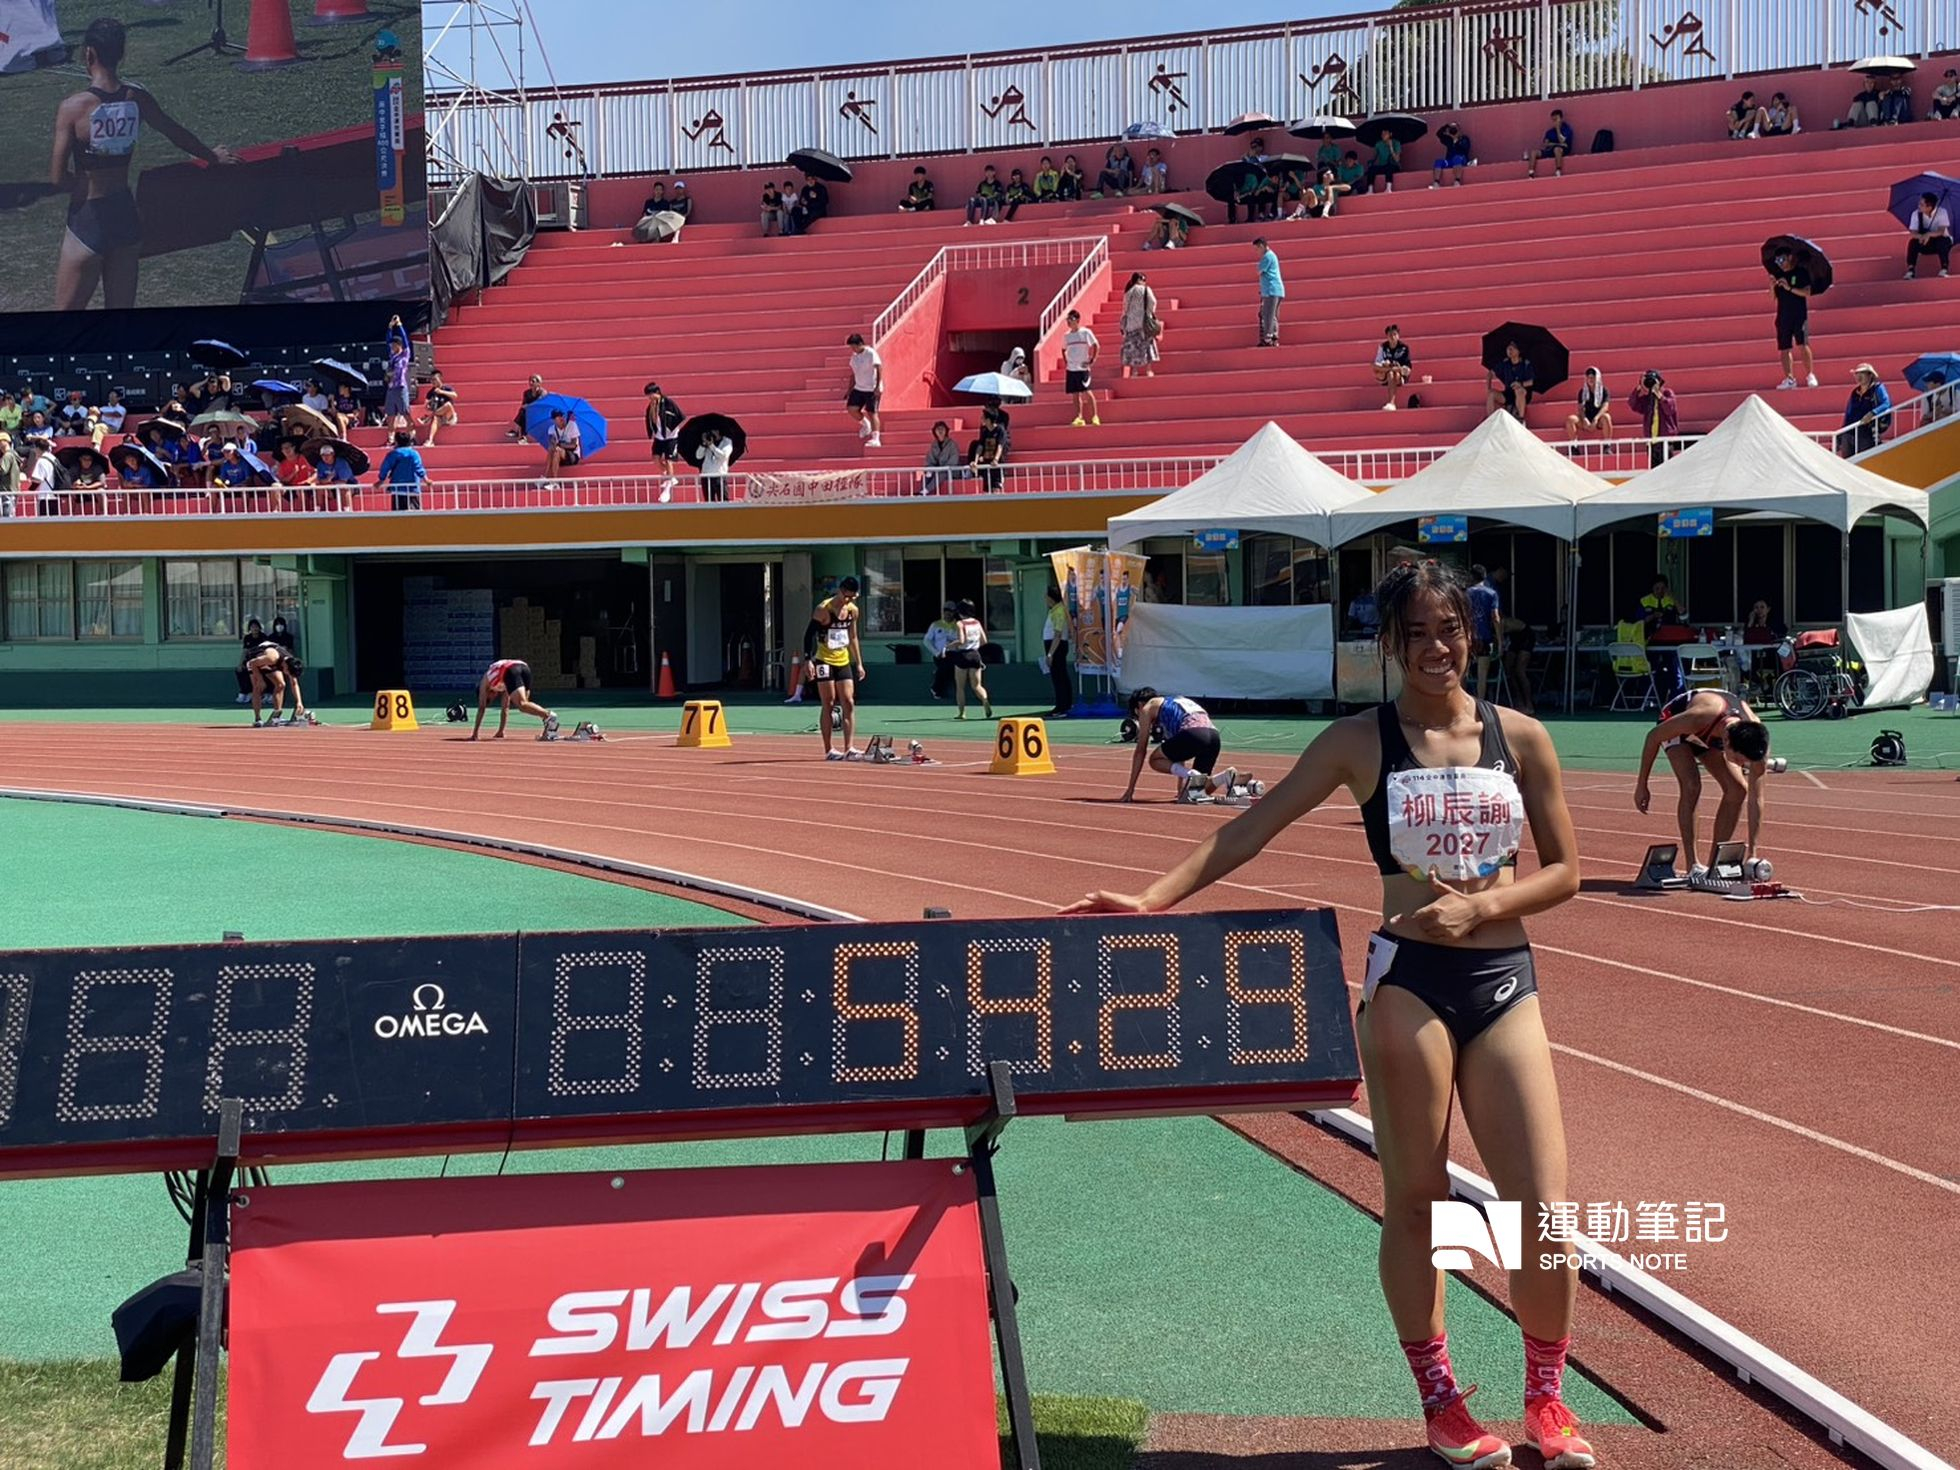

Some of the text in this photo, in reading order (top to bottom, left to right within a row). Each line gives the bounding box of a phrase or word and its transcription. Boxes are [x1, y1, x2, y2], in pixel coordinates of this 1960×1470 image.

[93, 117, 136, 139] 2027
[1017, 287, 1029, 305] 2
[377, 694, 388, 719] 8
[396, 694, 409, 719] 8
[685, 705, 698, 734] 7
[703, 705, 720, 734] 7
[999, 723, 1013, 759] 6
[1023, 723, 1042, 759] 6
[1402, 792, 1511, 827] 柳辰諭
[1426, 832, 1490, 856] 2027
[374, 1011, 489, 1038] OMEGA
[528, 1274, 917, 1357] SWISS
[528, 1358, 911, 1447] TIMING
